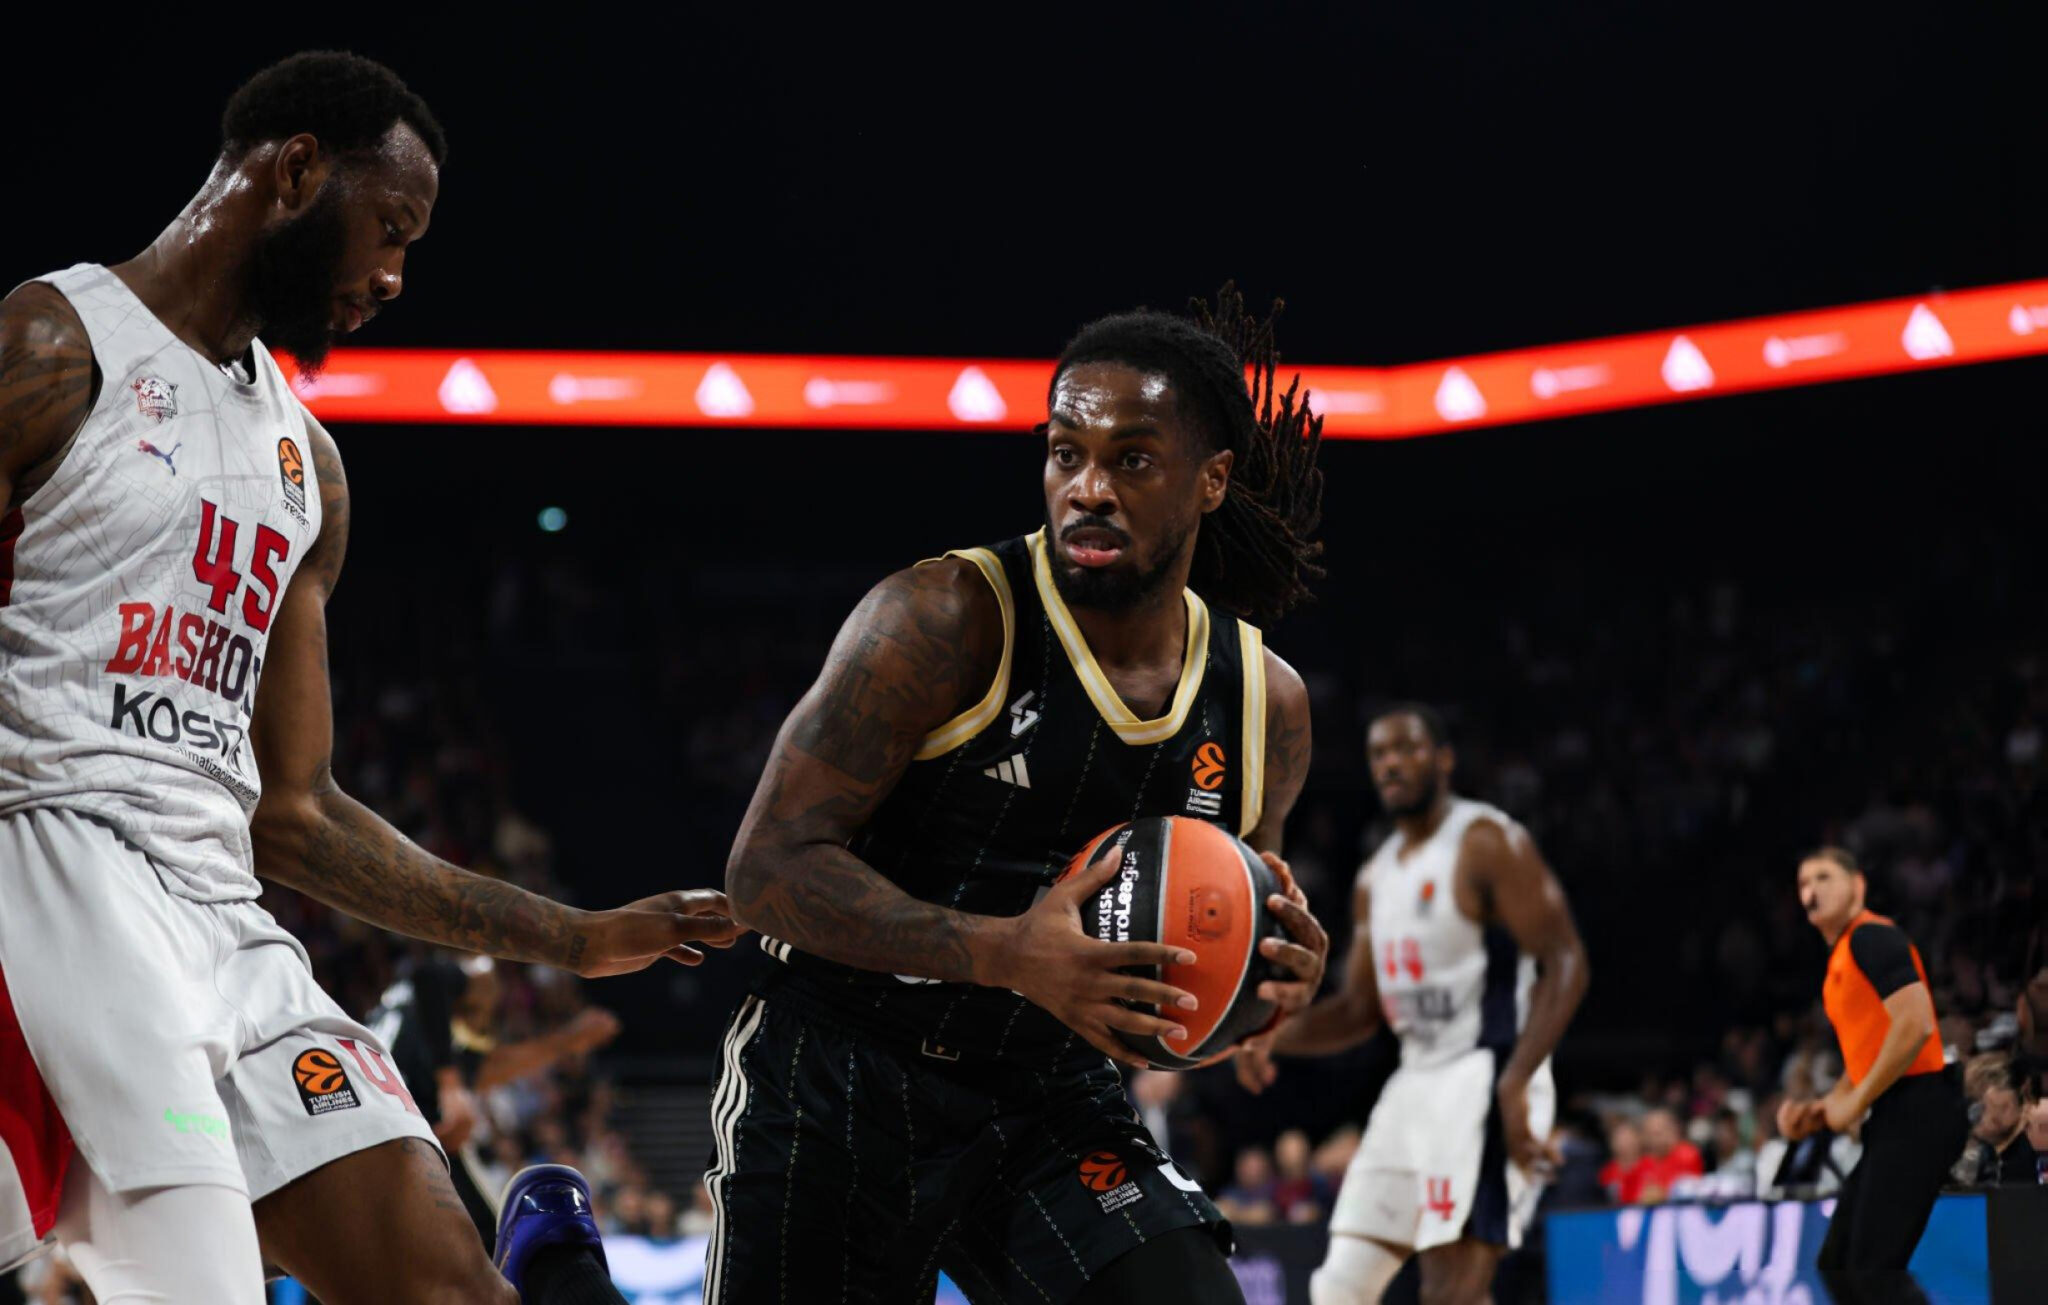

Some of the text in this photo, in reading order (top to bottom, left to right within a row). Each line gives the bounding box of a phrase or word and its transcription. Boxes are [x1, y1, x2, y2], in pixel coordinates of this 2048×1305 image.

[192, 498, 290, 635] 45
[104, 603, 260, 717] BASKO
[1099, 887, 1114, 942] RKISH
[1114, 851, 1140, 942] roLeague
[308, 1090, 351, 1104] TURKISH
[1096, 1181, 1137, 1202] TURKISH
[1101, 1187, 1140, 1208] AIRLINES
